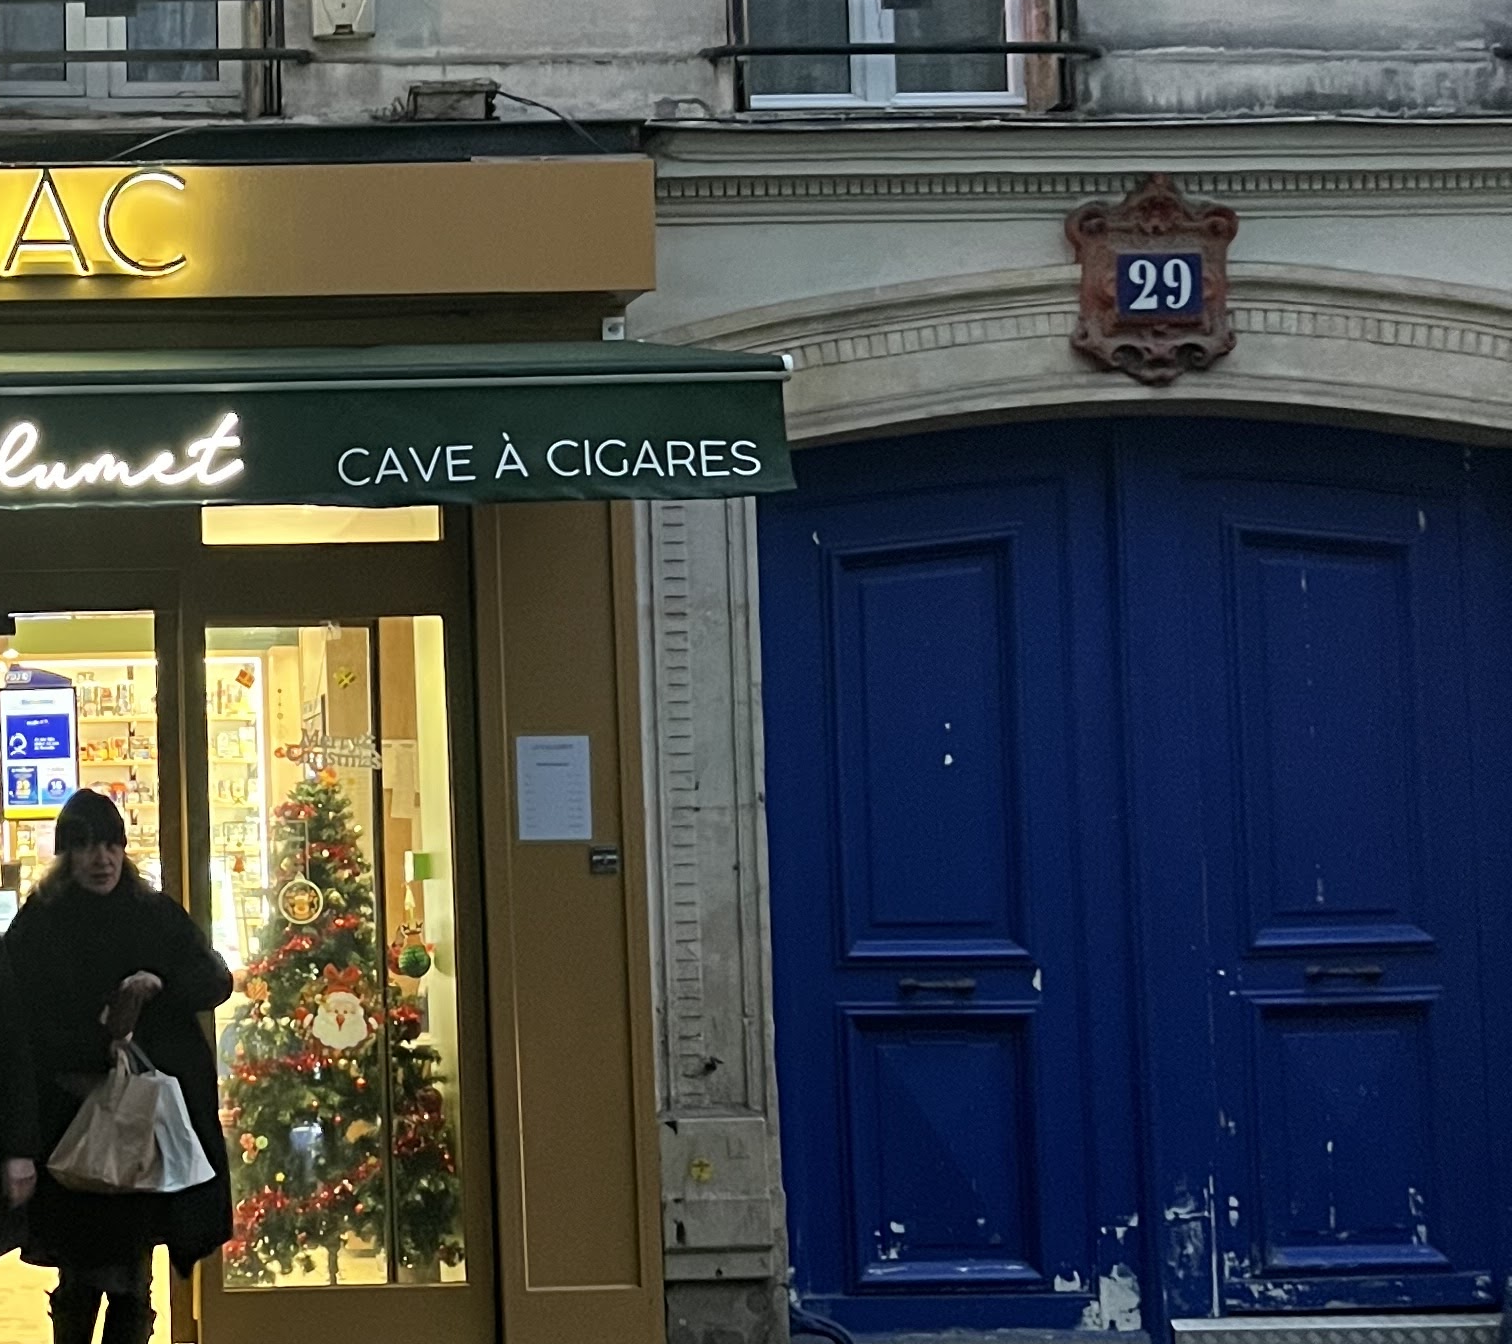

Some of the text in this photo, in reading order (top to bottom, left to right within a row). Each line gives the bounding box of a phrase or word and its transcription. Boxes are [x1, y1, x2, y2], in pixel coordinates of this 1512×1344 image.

[1129, 258, 1193, 310] 29
[337, 431, 763, 486] CAVE À CIGARES
